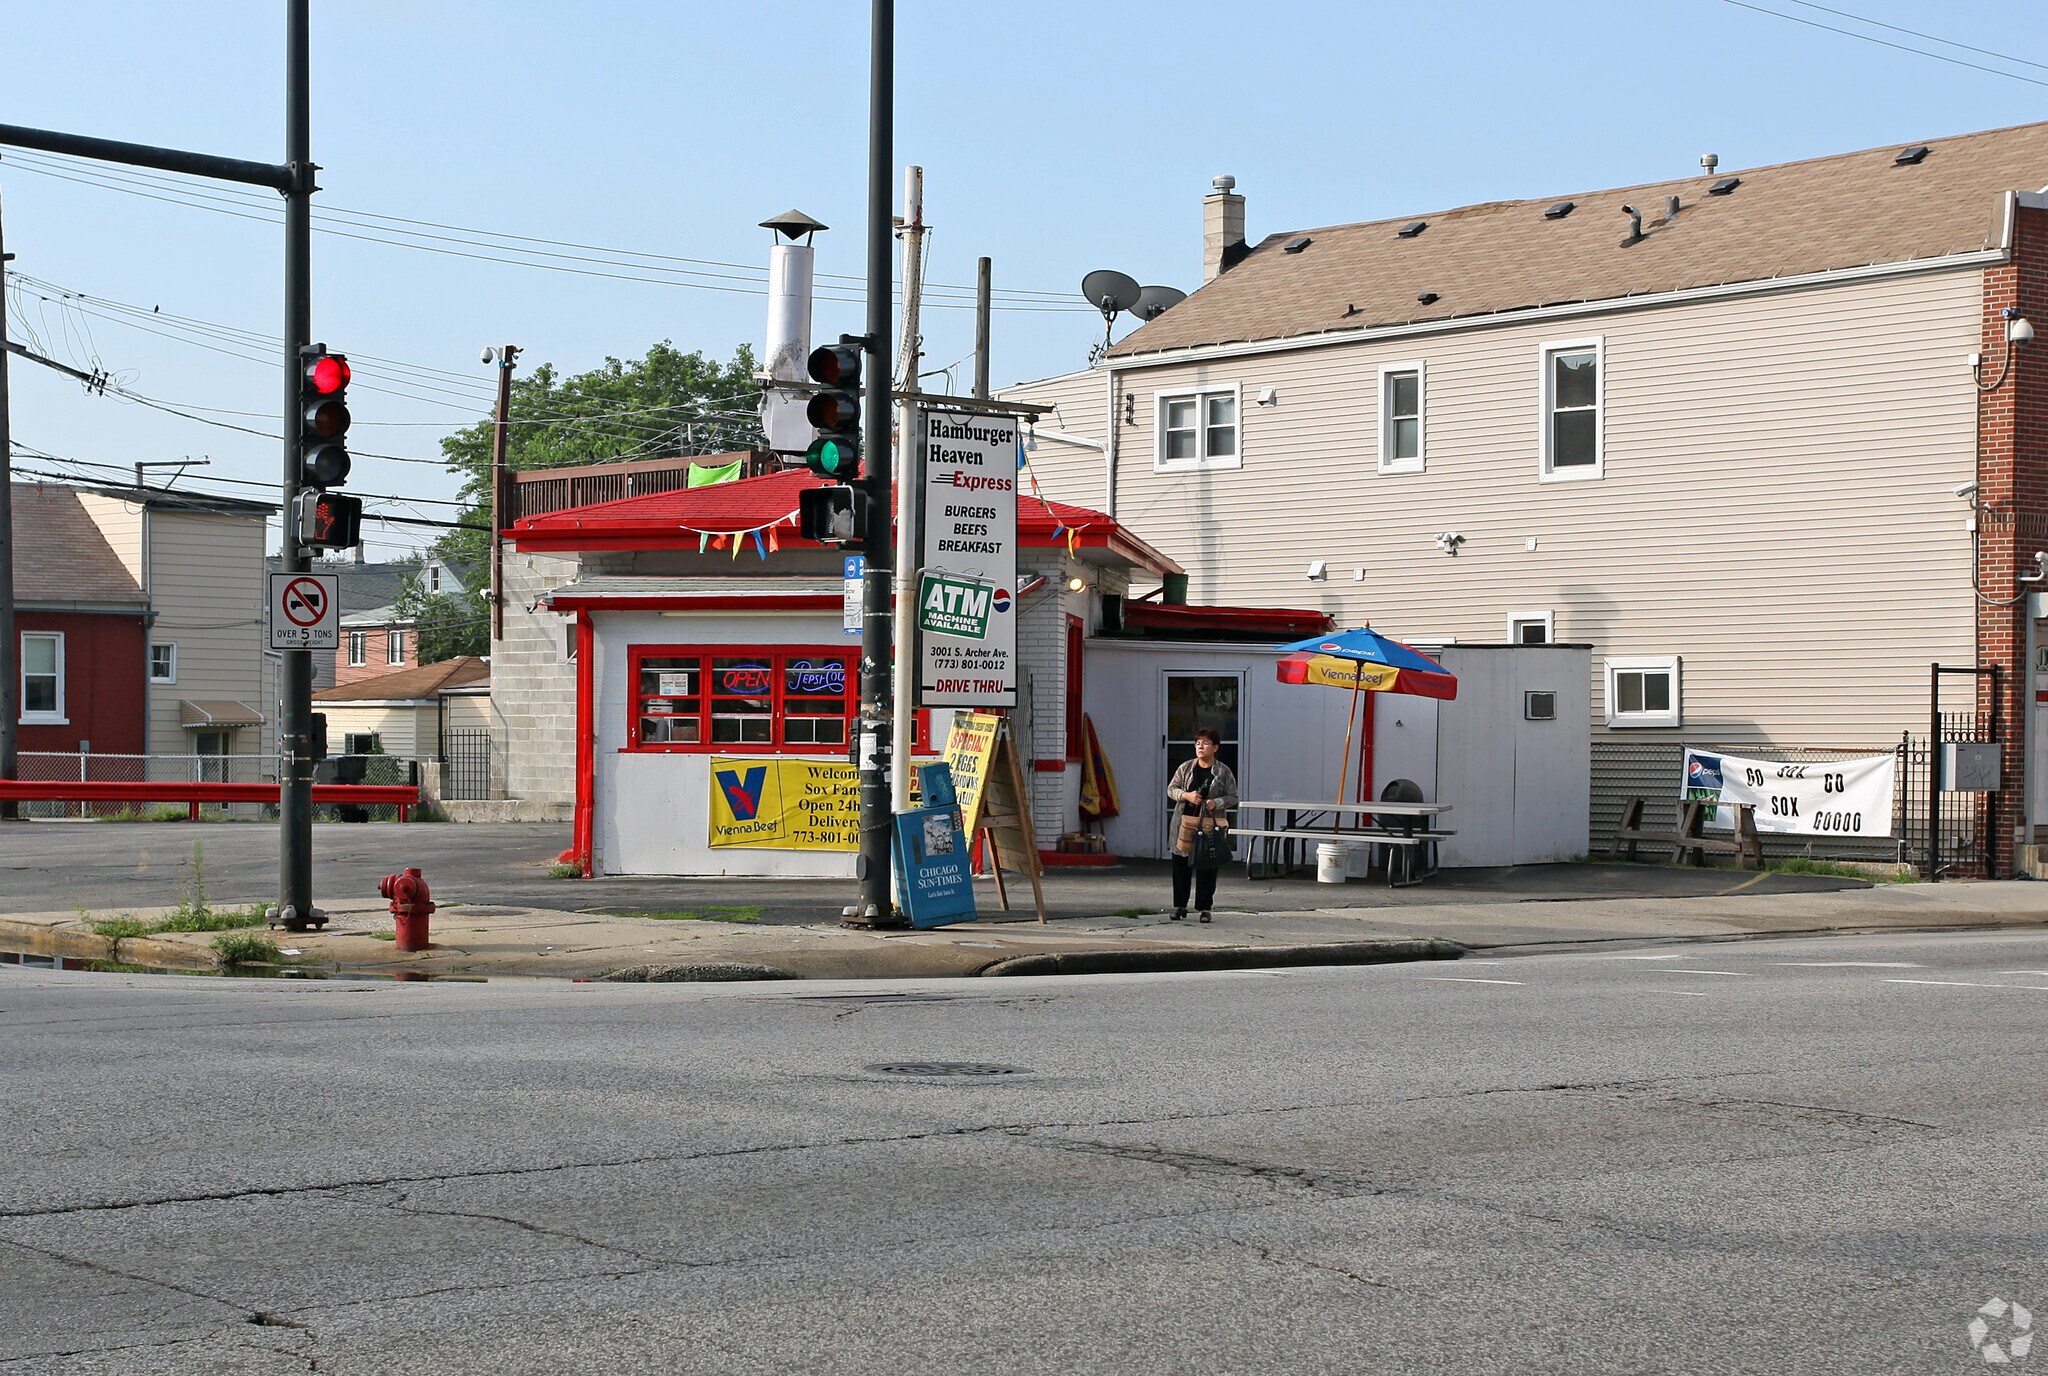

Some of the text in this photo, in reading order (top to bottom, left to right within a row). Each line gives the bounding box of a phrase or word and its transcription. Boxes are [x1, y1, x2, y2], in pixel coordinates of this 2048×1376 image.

[930, 419, 1013, 447] Hamburger
[929, 444, 983, 465] Heaven
[953, 470, 1012, 491] Express
[944, 505, 996, 519] BURGERS
[953, 523, 987, 536] BEEFS
[938, 540, 1002, 554] BREAKFAST
[924, 583, 988, 618] ATM
[923, 618, 981, 634] AVAILABLE
[928, 612, 978, 626] MACHINE
[277, 628, 332, 640] OVER 5 TONS
[930, 646, 1009, 658] 3001 S. Archer Ave.
[934, 659, 1005, 670] (773) 801-0012
[723, 669, 771, 689] OPEN
[1320, 666, 1384, 686] Vienna Beef
[935, 679, 1004, 694] DRIVE THRU
[950, 752, 957, 770] 2
[808, 766, 861, 780] Welcom
[1746, 767, 1764, 787] GO
[1824, 773, 1845, 793] GO
[804, 782, 828, 796] Sox
[798, 798, 833, 814] Open
[1771, 795, 1800, 818] SOX
[715, 819, 778, 836] Vienna Beef
[808, 814, 861, 832] Delivery
[792, 830, 861, 844] 773-801-00
[919, 864, 959, 878] CHICAGO
[917, 874, 963, 889] SUN-TIMES
